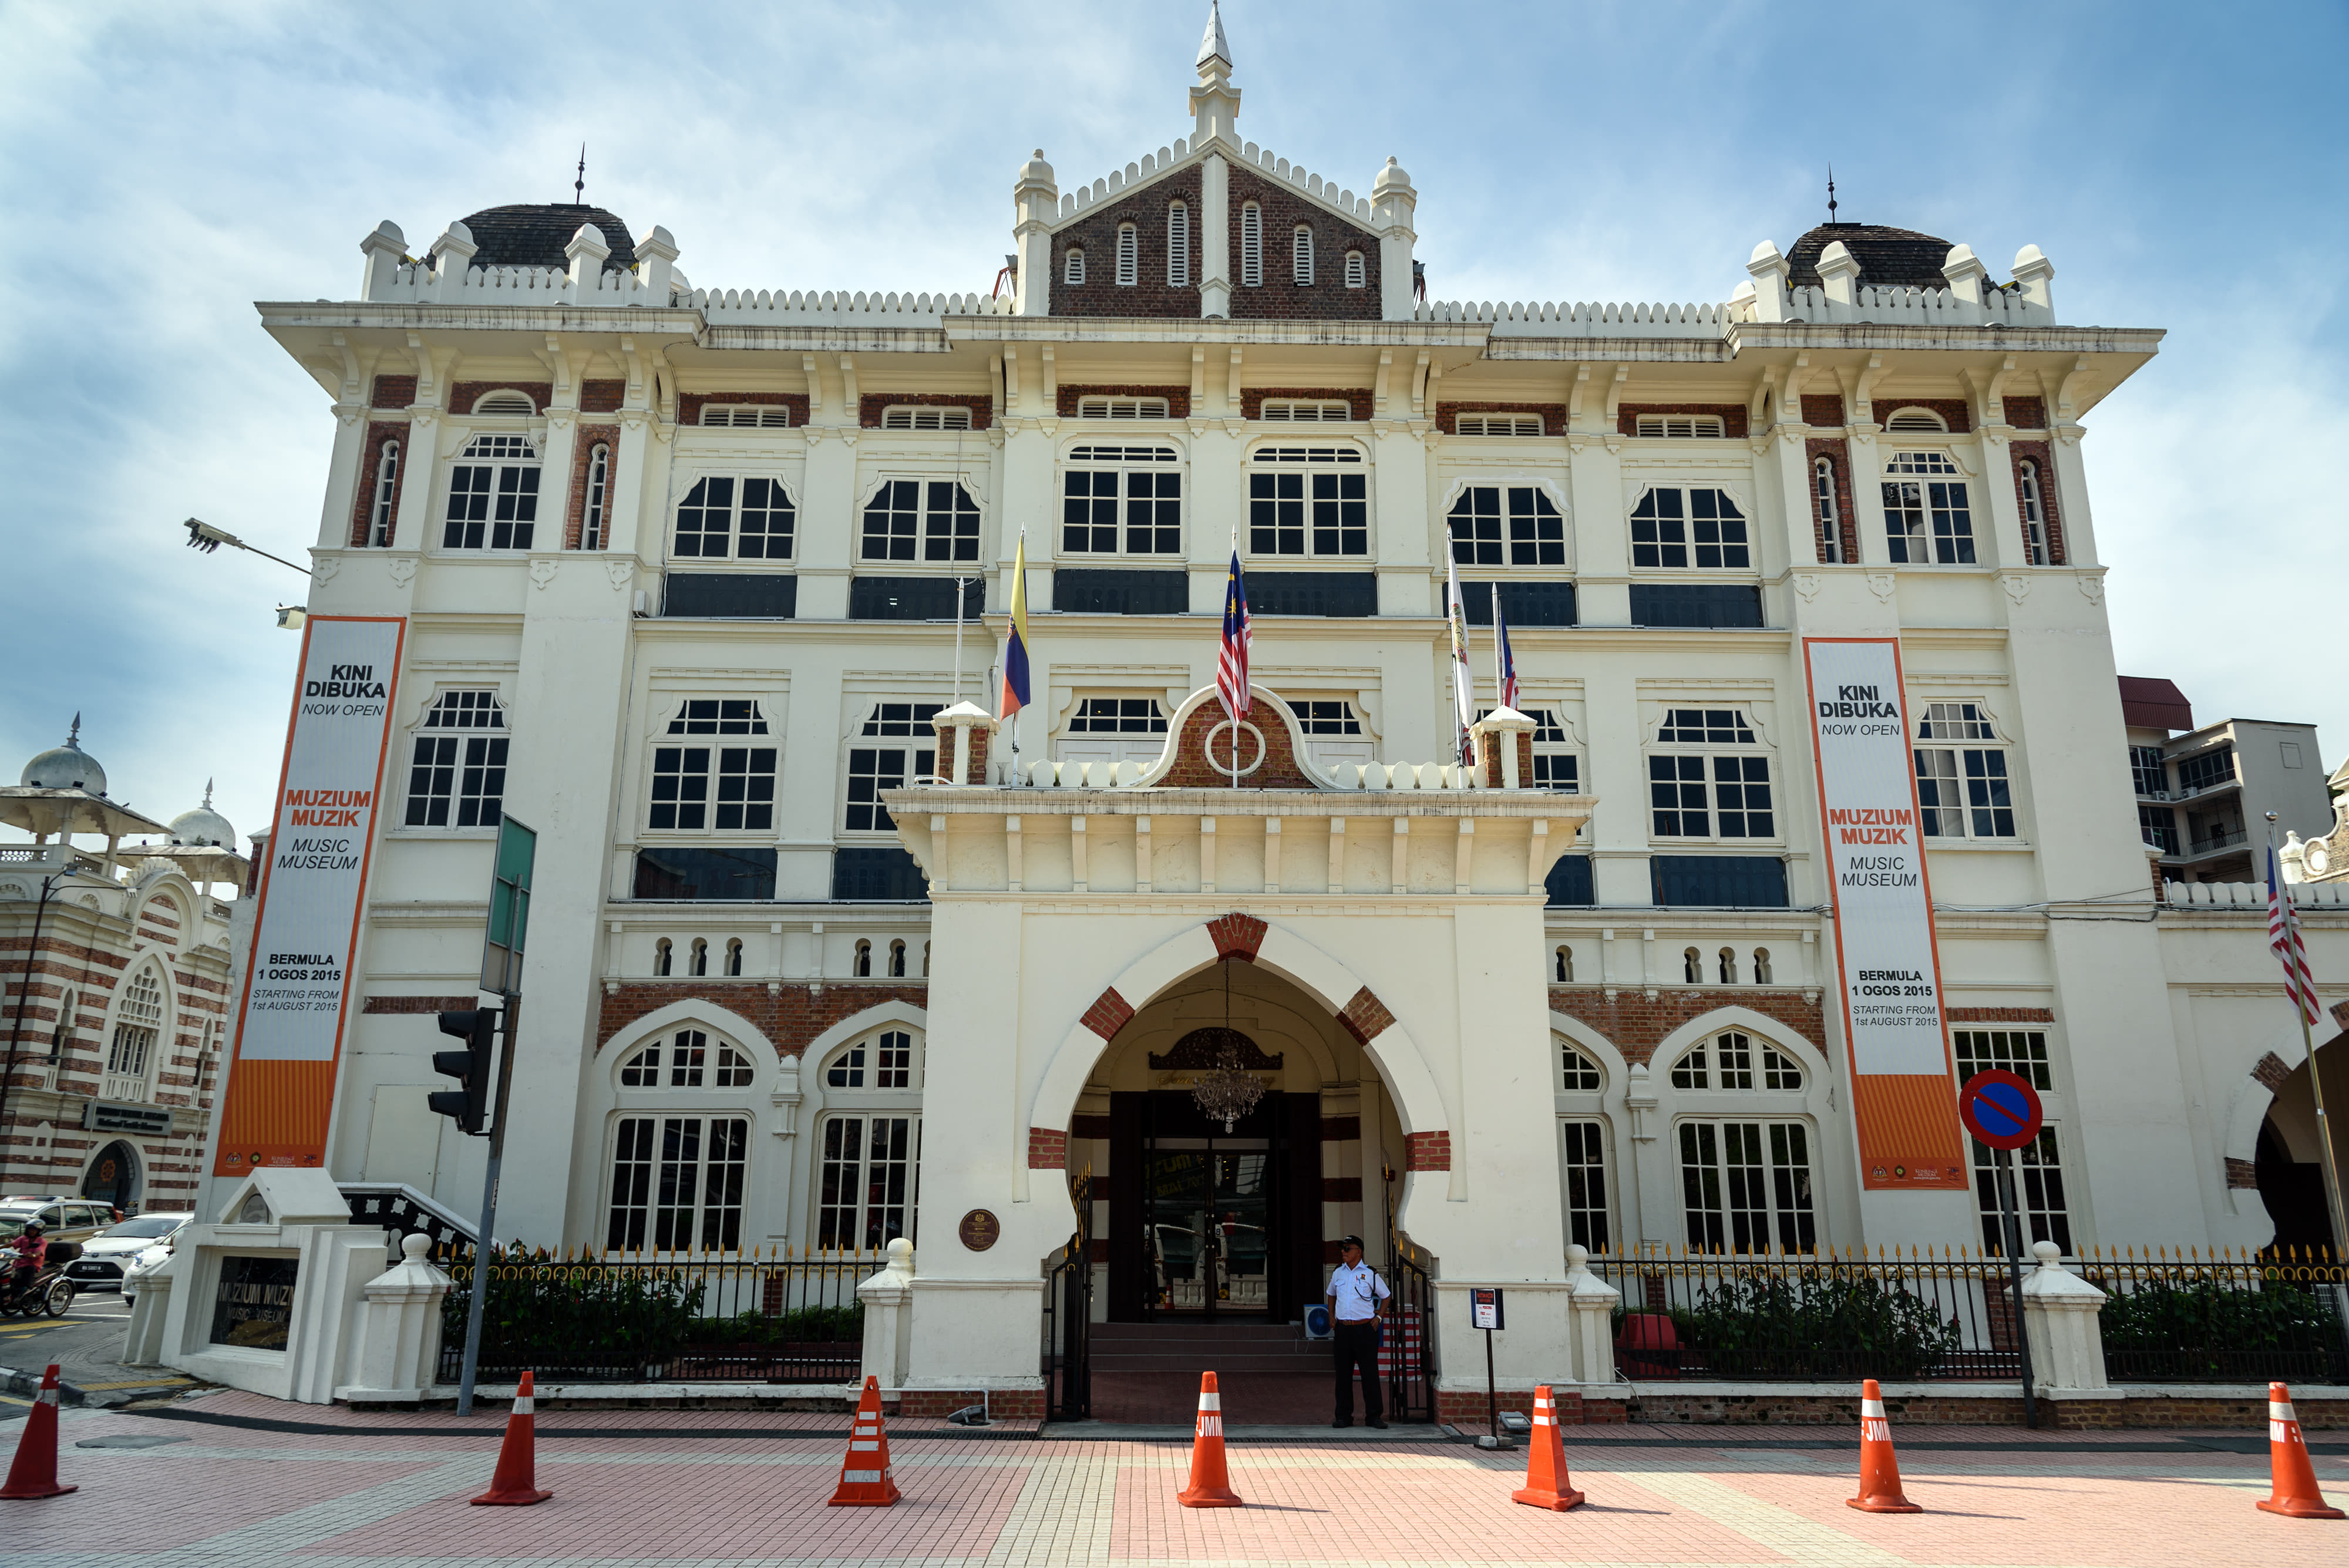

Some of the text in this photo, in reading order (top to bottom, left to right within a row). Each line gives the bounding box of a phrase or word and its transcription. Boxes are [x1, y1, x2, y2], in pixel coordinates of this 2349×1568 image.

[331, 665, 373, 681] KINI
[306, 681, 386, 698] DIBUKA
[1839, 685, 1879, 701] KINI
[302, 704, 384, 716] NOW OPEN
[1819, 702, 1899, 718] DIBUKA
[1822, 725, 1900, 735] NOW OPEN
[285, 789, 371, 807] MUZIUM
[291, 809, 361, 827] MUZIK
[1829, 809, 1912, 825] MUZIUM
[1840, 828, 1908, 844] MUZIK
[291, 839, 349, 852] MUSIC
[278, 855, 358, 869] MUSEUM
[1850, 857, 1904, 870] MUSIC
[1842, 873, 1917, 886] MUSEUM
[269, 954, 334, 965] BERMULA
[258, 969, 341, 980] 1 OGOS 2015
[1859, 970, 1923, 981] BERMULA
[253, 990, 339, 999] STARTING FROM
[1852, 985, 1932, 996] 1 OGOS 2015
[267, 1002, 312, 1010] AUGUST
[314, 1002, 338, 1011] 2015
[1906, 1006, 1936, 1014] FROM
[1916, 1018, 1938, 1026] 2015
